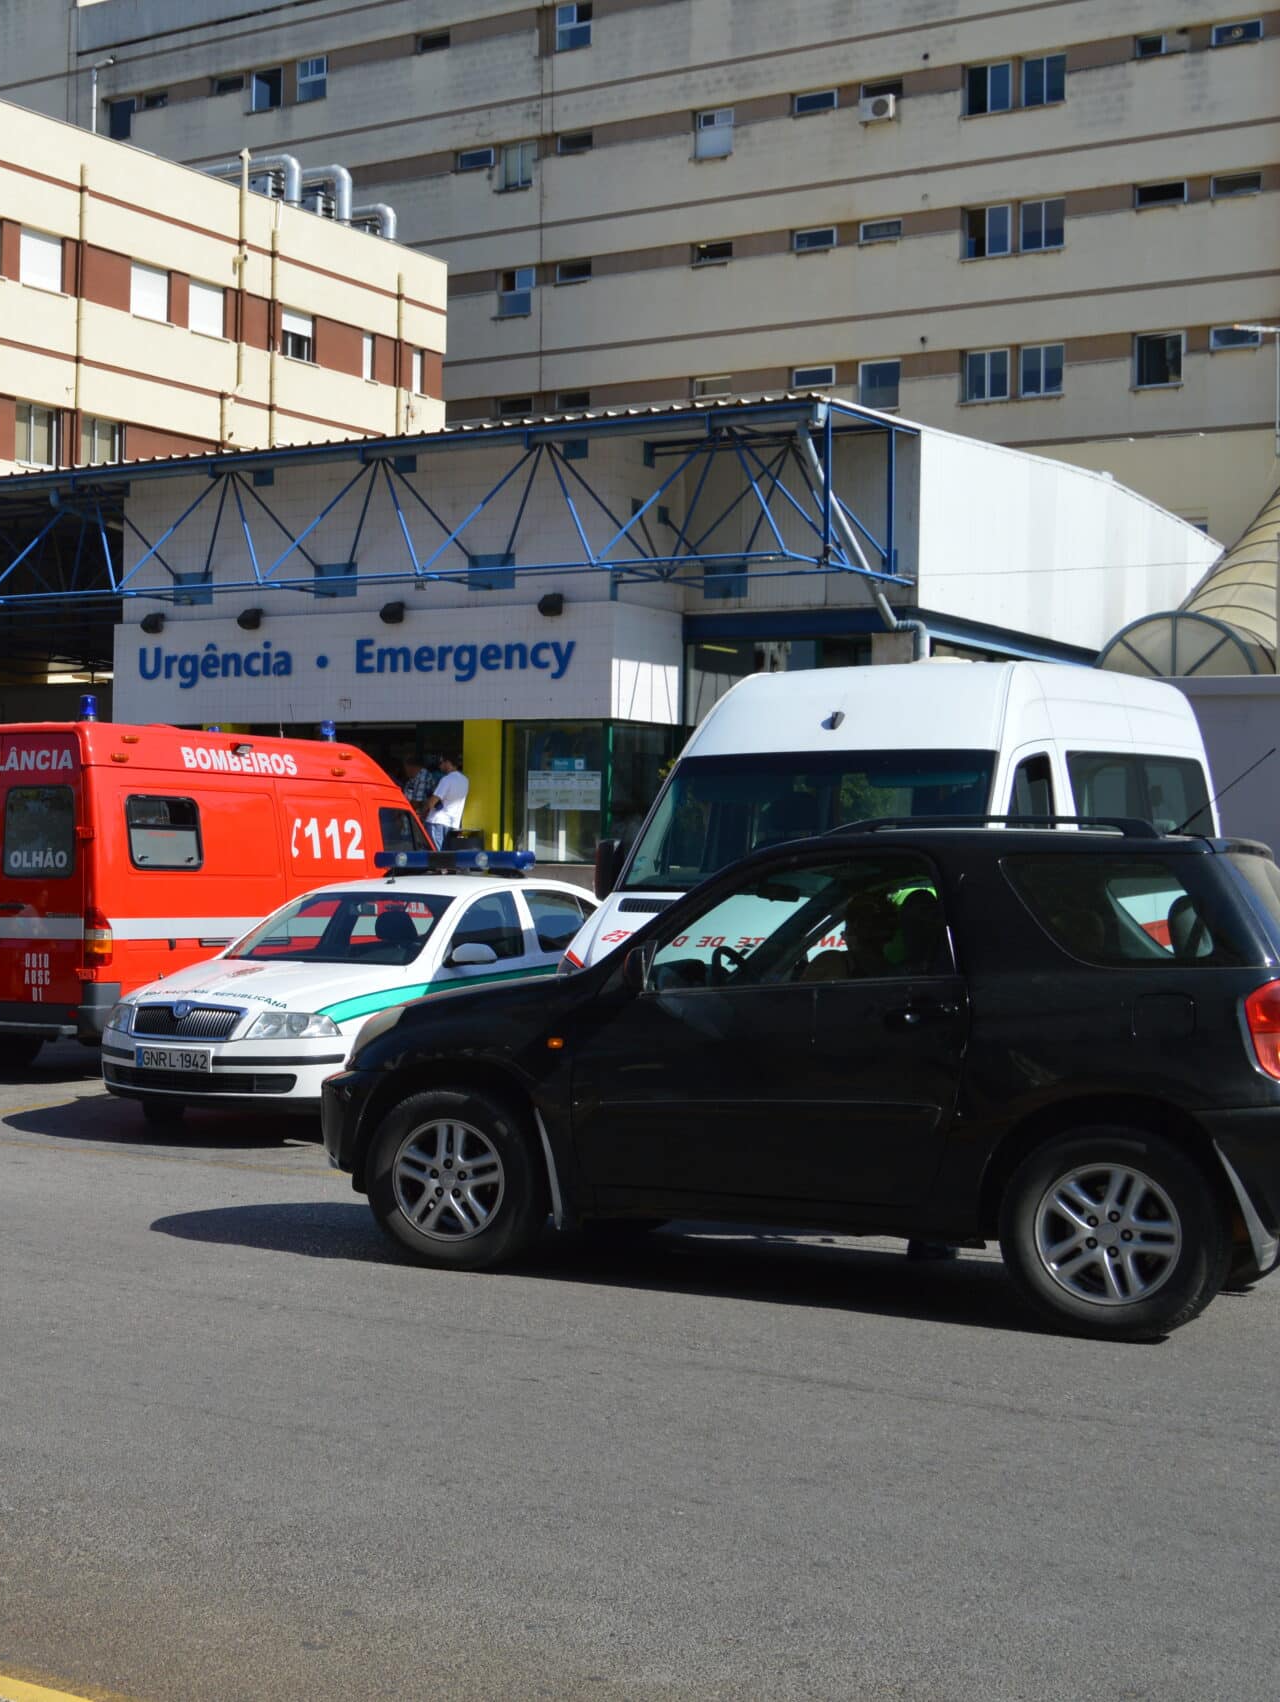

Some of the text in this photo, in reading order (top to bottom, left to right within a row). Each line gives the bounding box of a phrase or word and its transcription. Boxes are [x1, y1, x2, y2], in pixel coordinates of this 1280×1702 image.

[139, 638, 576, 689] Urgência Emergency
[180, 746, 298, 776] BOMBEIROS
[304, 817, 366, 860] 112
[9, 847, 68, 869] OLHÃO
